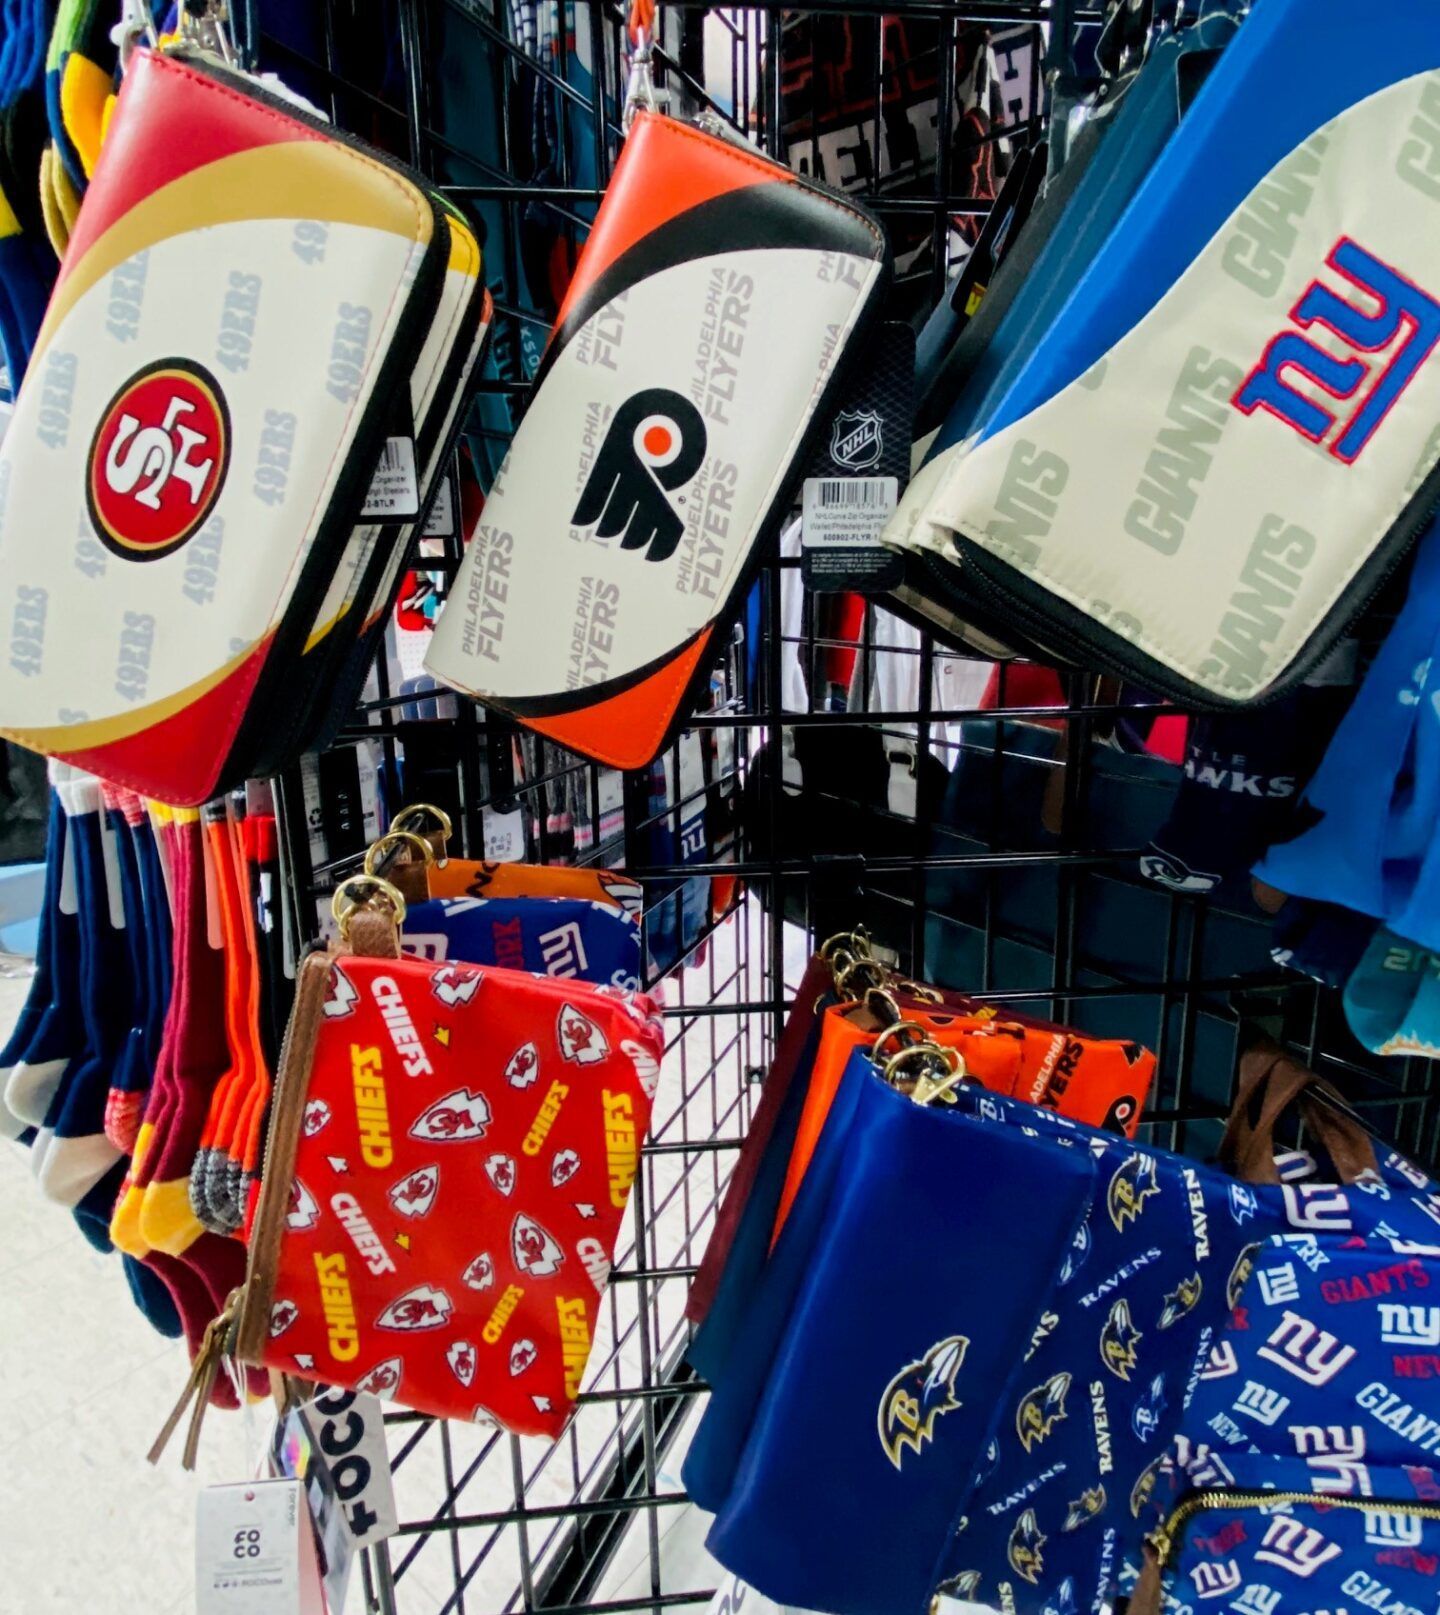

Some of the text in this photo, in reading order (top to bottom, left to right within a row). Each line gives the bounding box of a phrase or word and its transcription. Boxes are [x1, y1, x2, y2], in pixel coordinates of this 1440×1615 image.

[105, 248, 150, 343] 49ER
[216, 270, 262, 374] 49ERS
[692, 267, 727, 414] HILADELPHIA
[326, 301, 372, 404] 49ERS
[704, 269, 754, 427] FLYERS
[36, 349, 78, 449] 49ERS
[842, 426, 873, 457] NHL
[253, 409, 297, 506] 49ERS
[1123, 344, 1246, 558] GIANTS
[692, 457, 738, 601] FLYERS
[9, 585, 49, 678] 49ERS
[461, 524, 490, 658] PHILADELPHIA
[477, 527, 514, 664] FLYERS
[566, 576, 594, 693] HILADELPHIA
[115, 611, 155, 702] 49ERS
[370, 975, 436, 1079] CHIEFS
[350, 1043, 394, 1170] CHIEFS
[521, 1079, 571, 1158] CHIEFS
[602, 1088, 640, 1208] CHIEFS
[330, 1191, 397, 1277] CHIEFS
[1183, 1167, 1210, 1263] RAVEN
[312, 1252, 361, 1363] CHIEFS
[481, 1283, 526, 1346] CHIEFS
[1078, 1246, 1162, 1308] RAVENS
[1320, 1258, 1430, 1304] GIANTS
[555, 1295, 593, 1401] CHIEFS
[1089, 1380, 1114, 1475] RAVENS
[1206, 1412, 1249, 1445] NEW
[987, 1462, 1067, 1516] RAVENS
